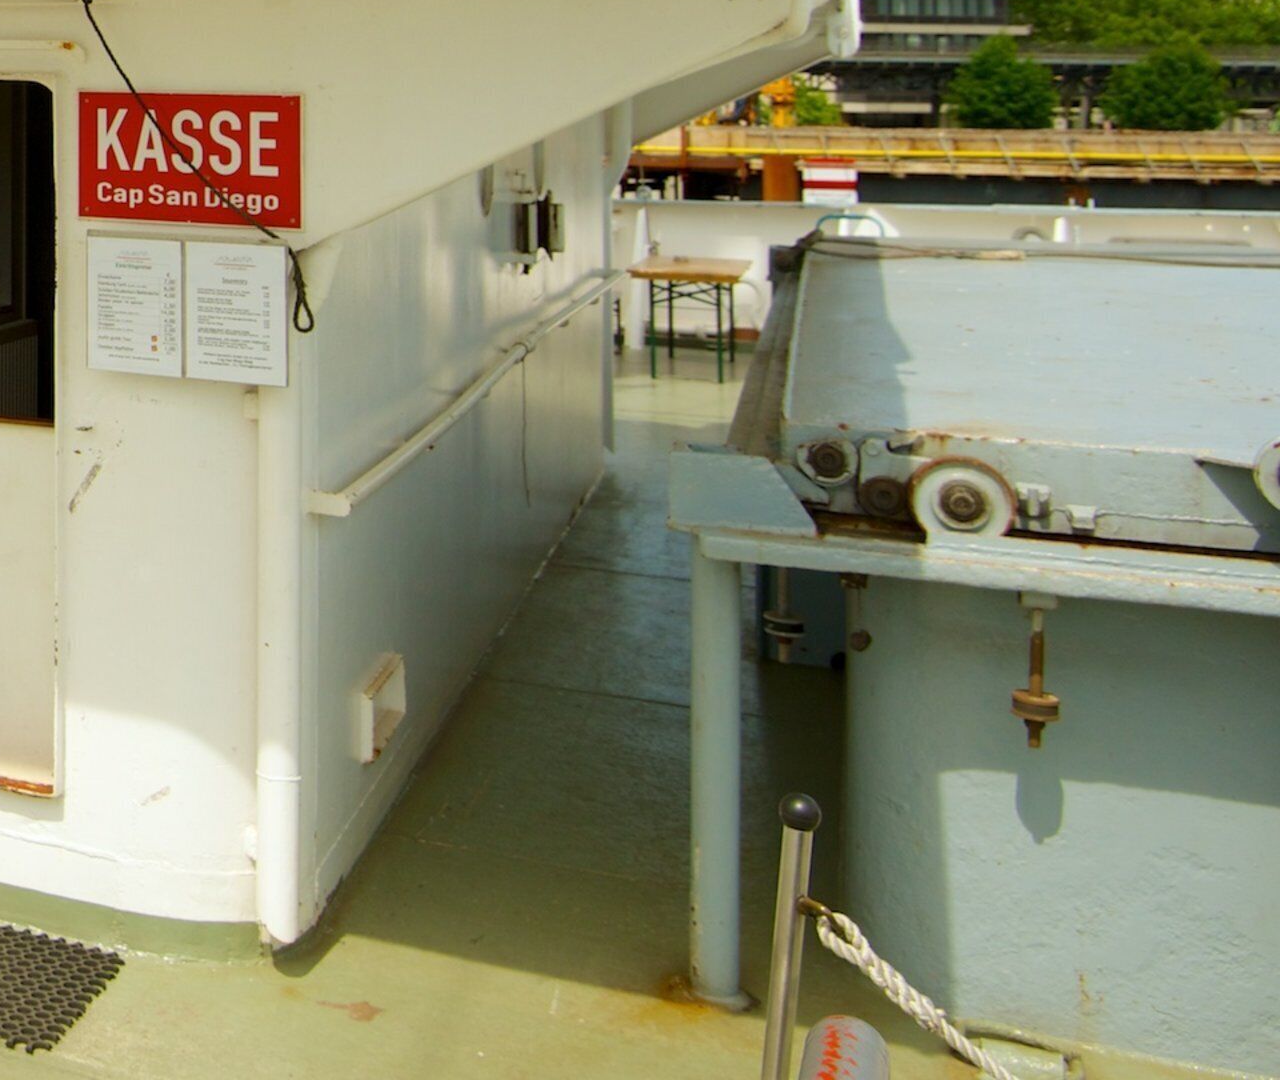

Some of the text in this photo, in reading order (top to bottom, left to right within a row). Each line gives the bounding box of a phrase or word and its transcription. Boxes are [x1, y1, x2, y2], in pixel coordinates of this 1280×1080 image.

[97, 108, 280, 177] KASSE
[97, 182, 280, 215] Cap San Diego
